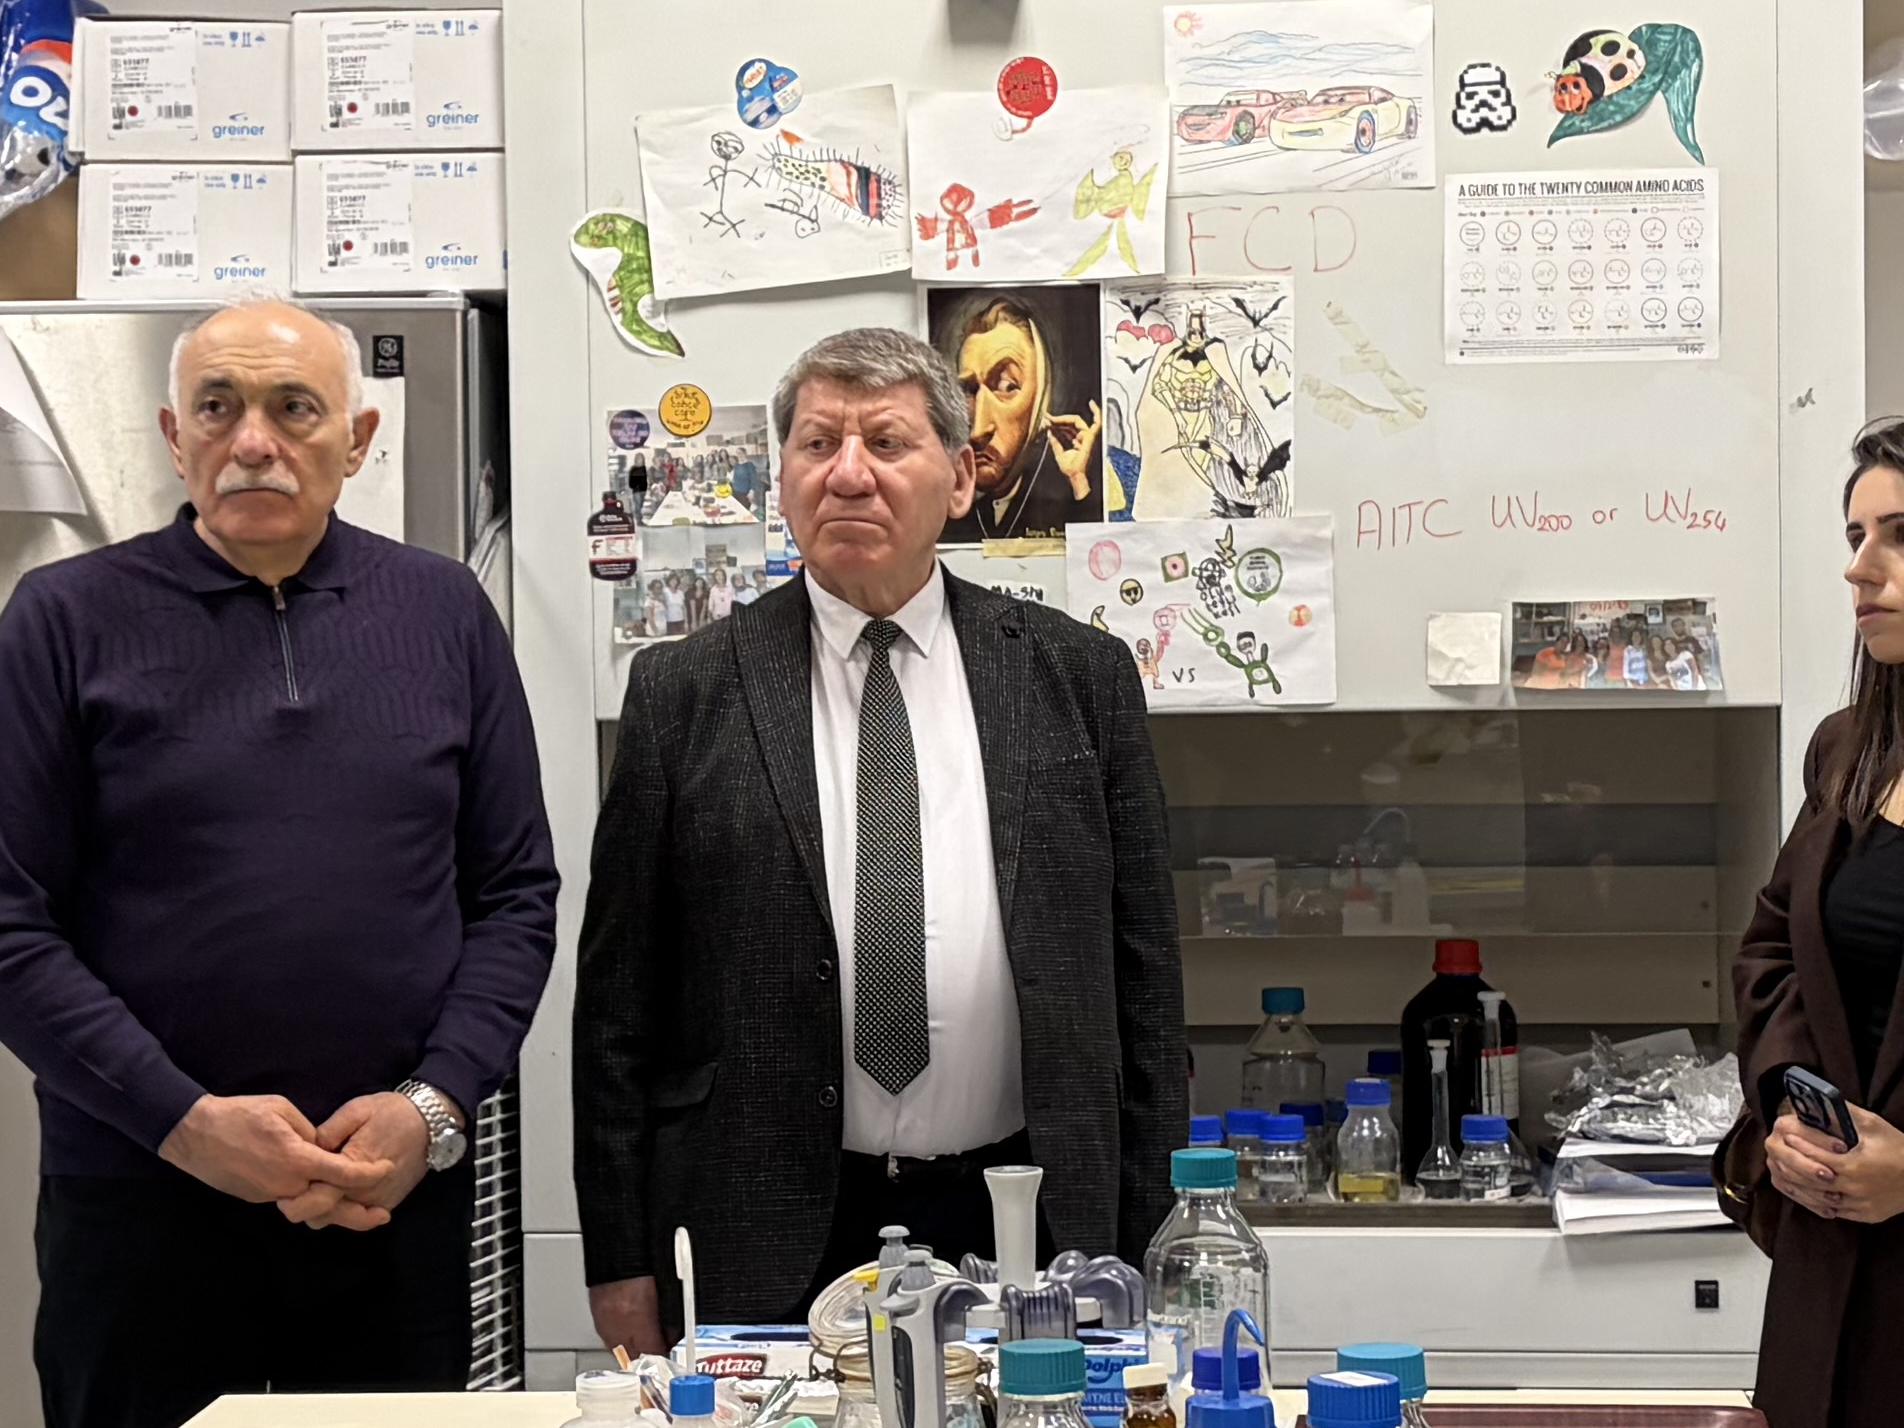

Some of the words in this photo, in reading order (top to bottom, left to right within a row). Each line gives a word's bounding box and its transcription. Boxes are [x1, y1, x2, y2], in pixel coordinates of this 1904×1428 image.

[426, 112, 479, 128] greiner
[212, 123, 265, 139] greiner
[1458, 184, 1466, 197] A
[1467, 183, 1498, 196] GUIDE
[1501, 182, 1516, 196] TO
[1517, 182, 1537, 196] THE
[1539, 181, 1583, 195] TWENTY
[1583, 180, 1634, 194] COMMON
[1635, 179, 1671, 193] AMINO
[1672, 178, 1705, 193] ACIDS
[425, 254, 479, 269] greiner
[213, 266, 266, 281] greiner
[1355, 497, 1464, 551] AITC
[1591, 506, 1619, 526] or
